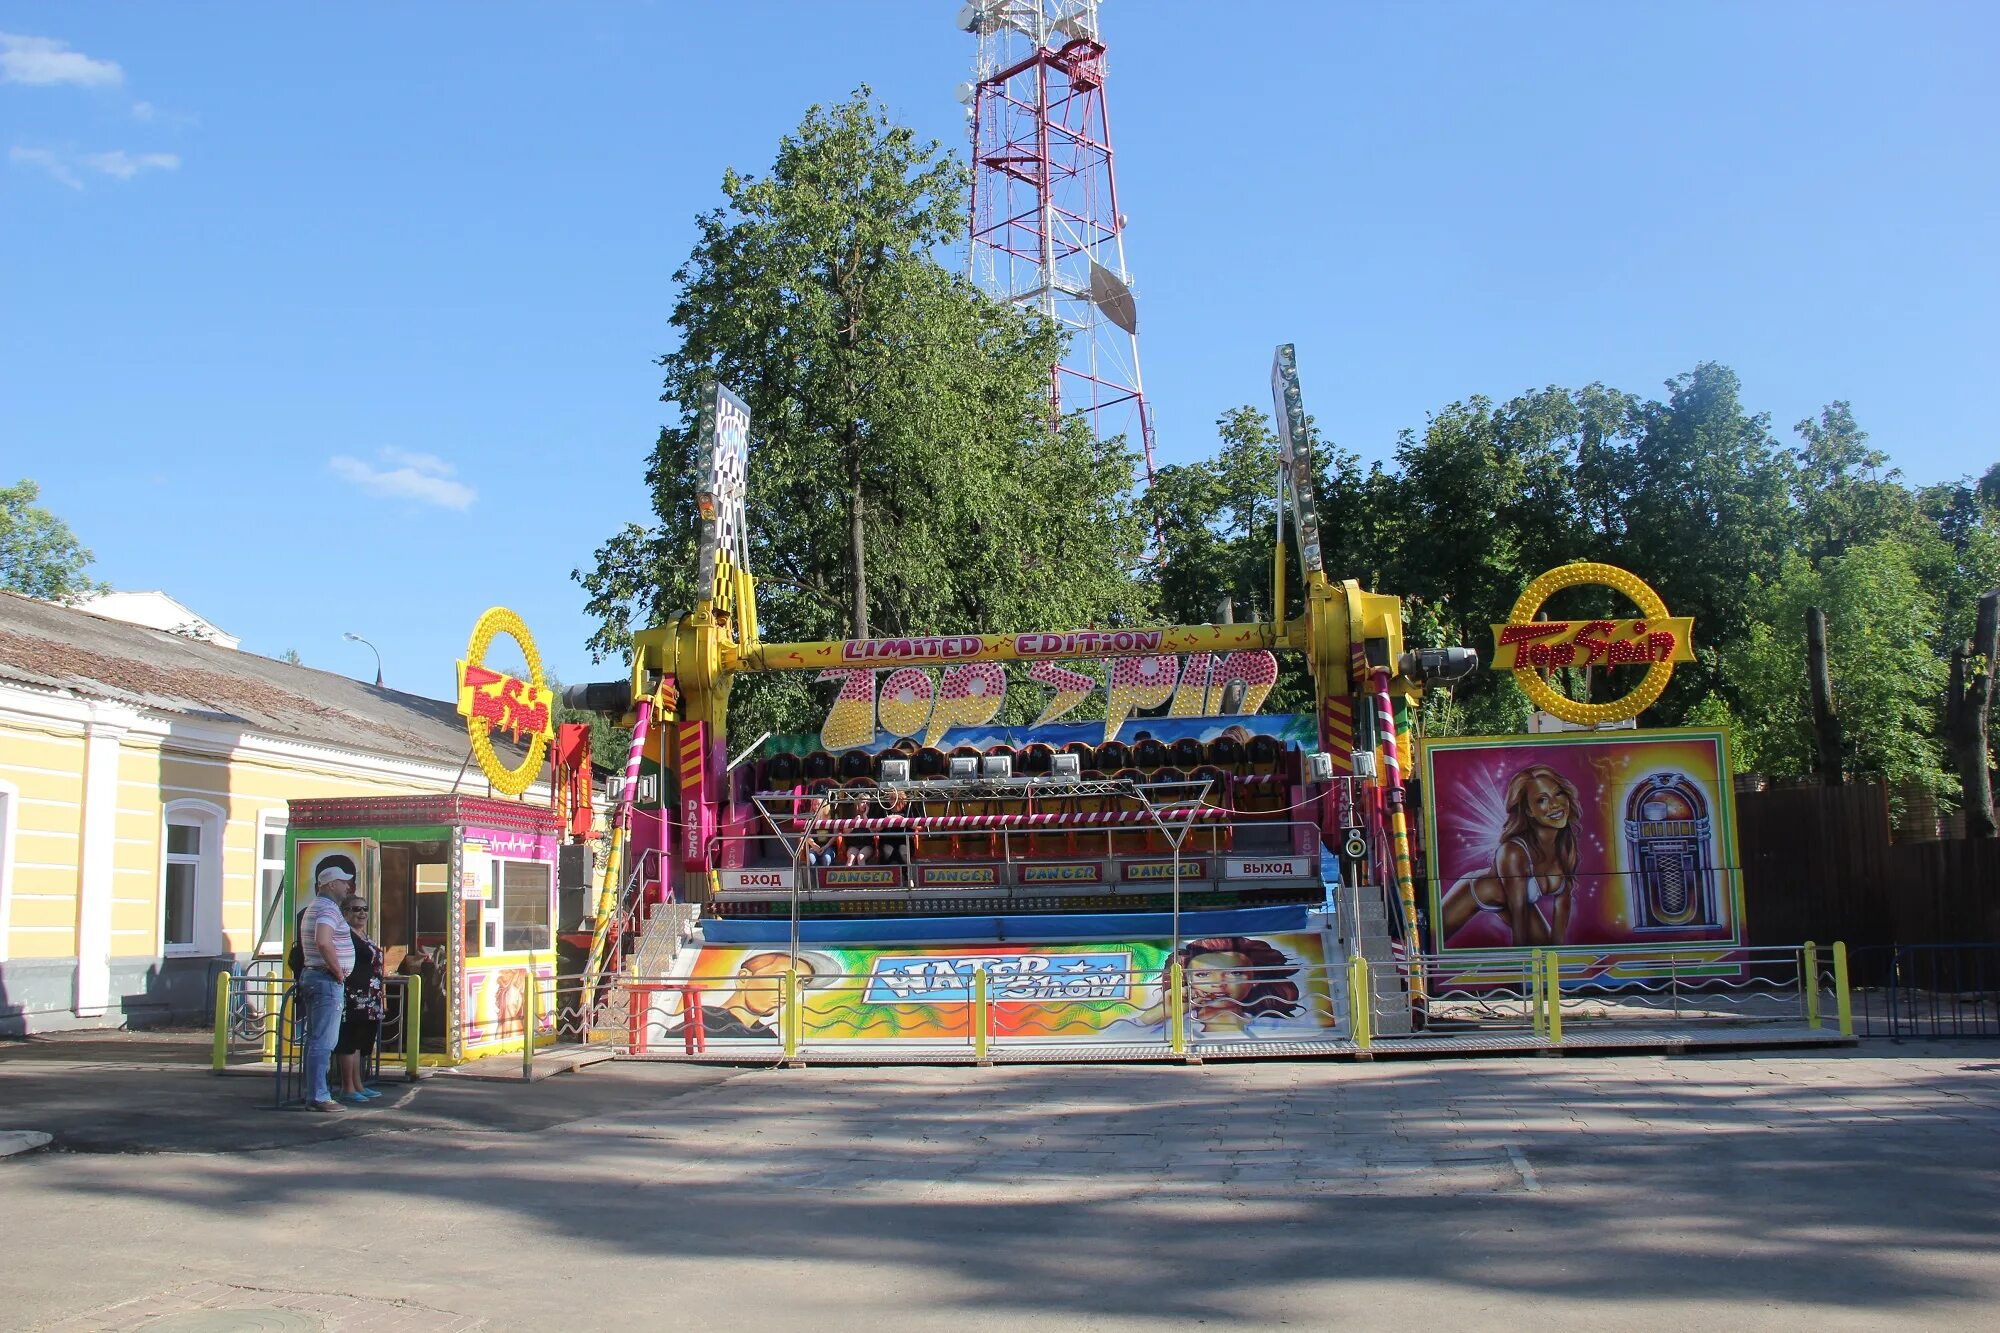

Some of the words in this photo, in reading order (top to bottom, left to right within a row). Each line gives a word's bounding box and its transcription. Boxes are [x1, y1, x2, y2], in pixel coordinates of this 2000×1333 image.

[688, 799, 698, 859] DANGER
[1025, 867, 1096, 880] DANGER
[1243, 863, 1293, 875] ВЫХОД
[740, 874, 782, 886] ВХОД
[827, 871, 891, 883] DANGER
[925, 870, 993, 883] DANGER
[878, 956, 1050, 998] WATER
